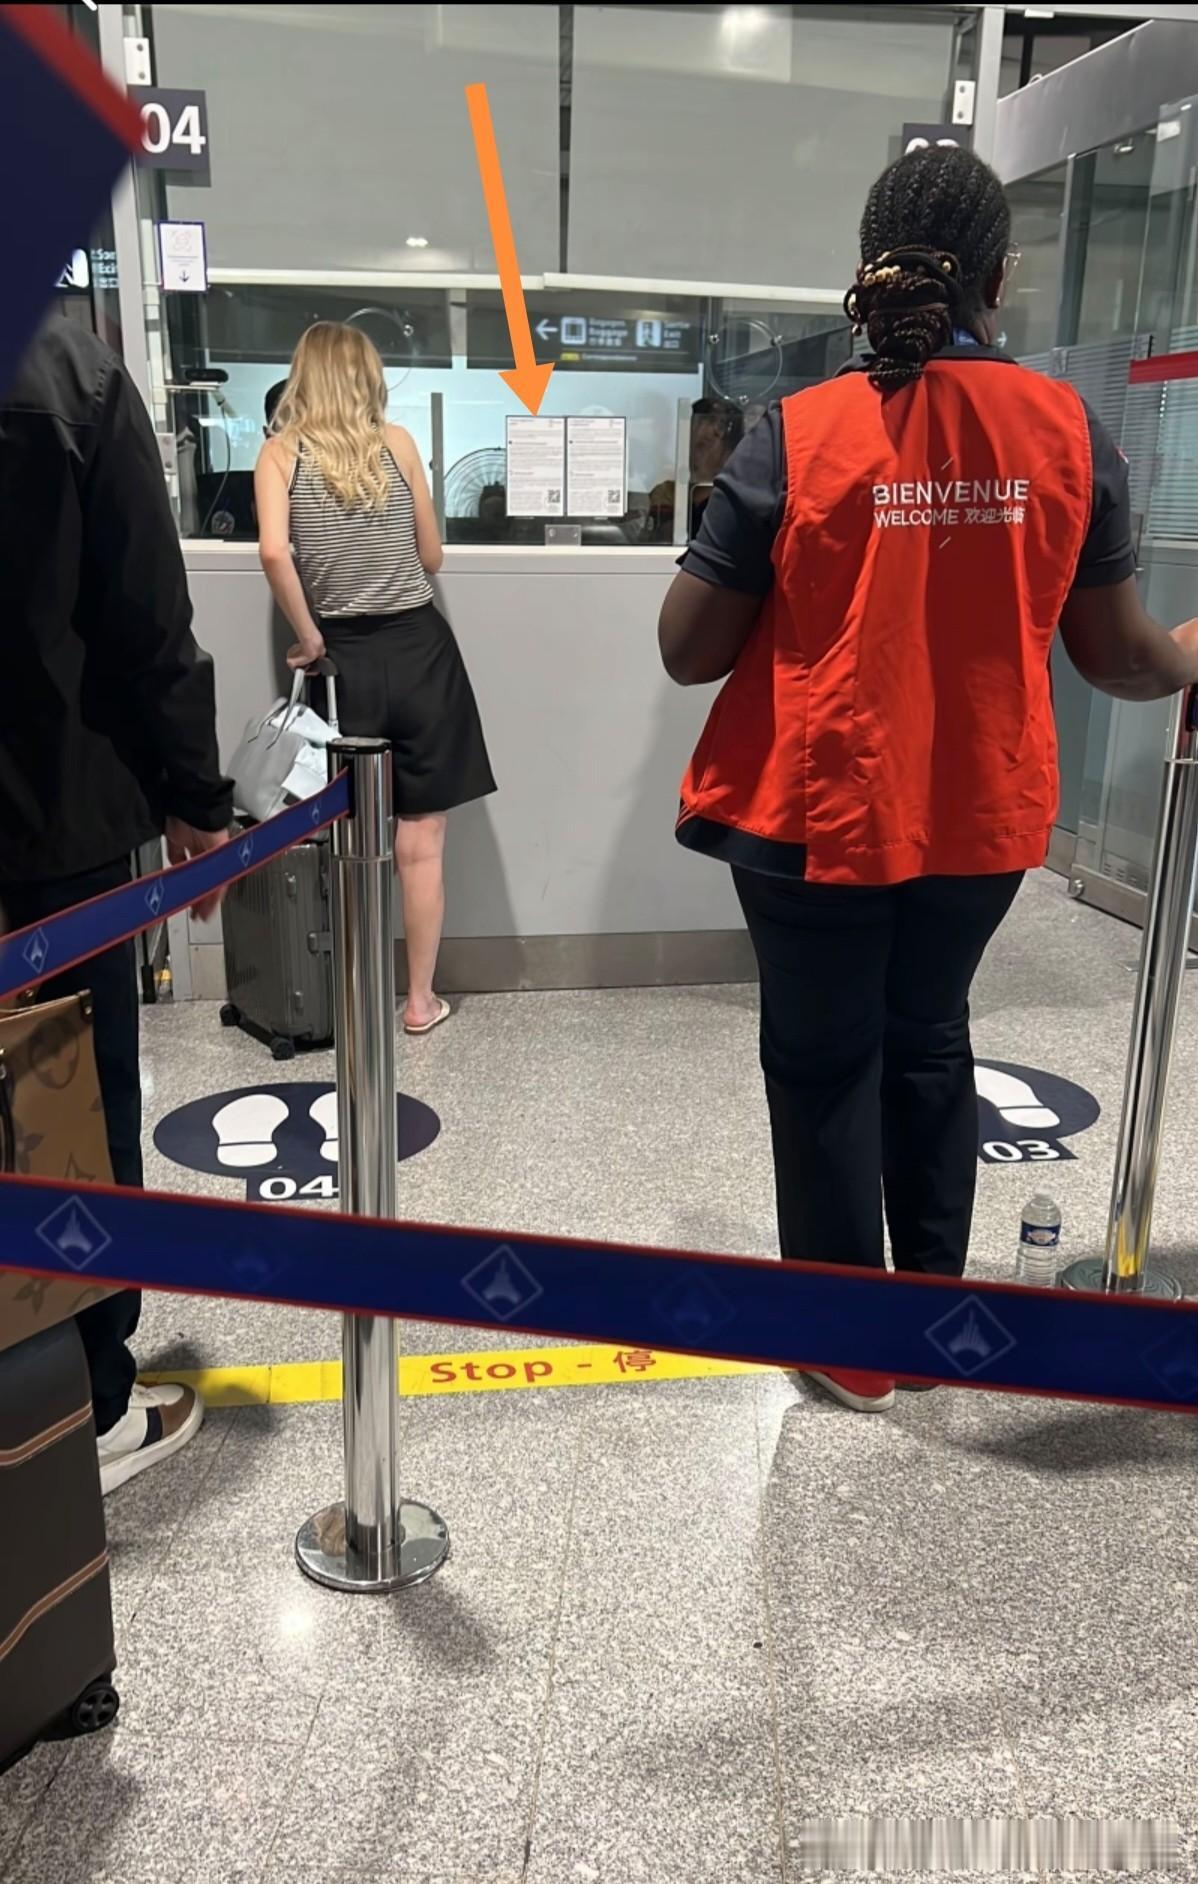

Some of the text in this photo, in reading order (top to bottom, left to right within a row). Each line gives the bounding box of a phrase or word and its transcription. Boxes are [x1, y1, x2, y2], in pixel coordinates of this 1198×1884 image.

[141, 103, 206, 154] 04
[873, 479, 1030, 505] BIENVENUE
[874, 508, 959, 528] WELCOME
[983, 1139, 1060, 1161] 03
[259, 1175, 340, 1200] 04
[430, 1361, 553, 1383] Stop
[613, 1350, 657, 1373] 停
